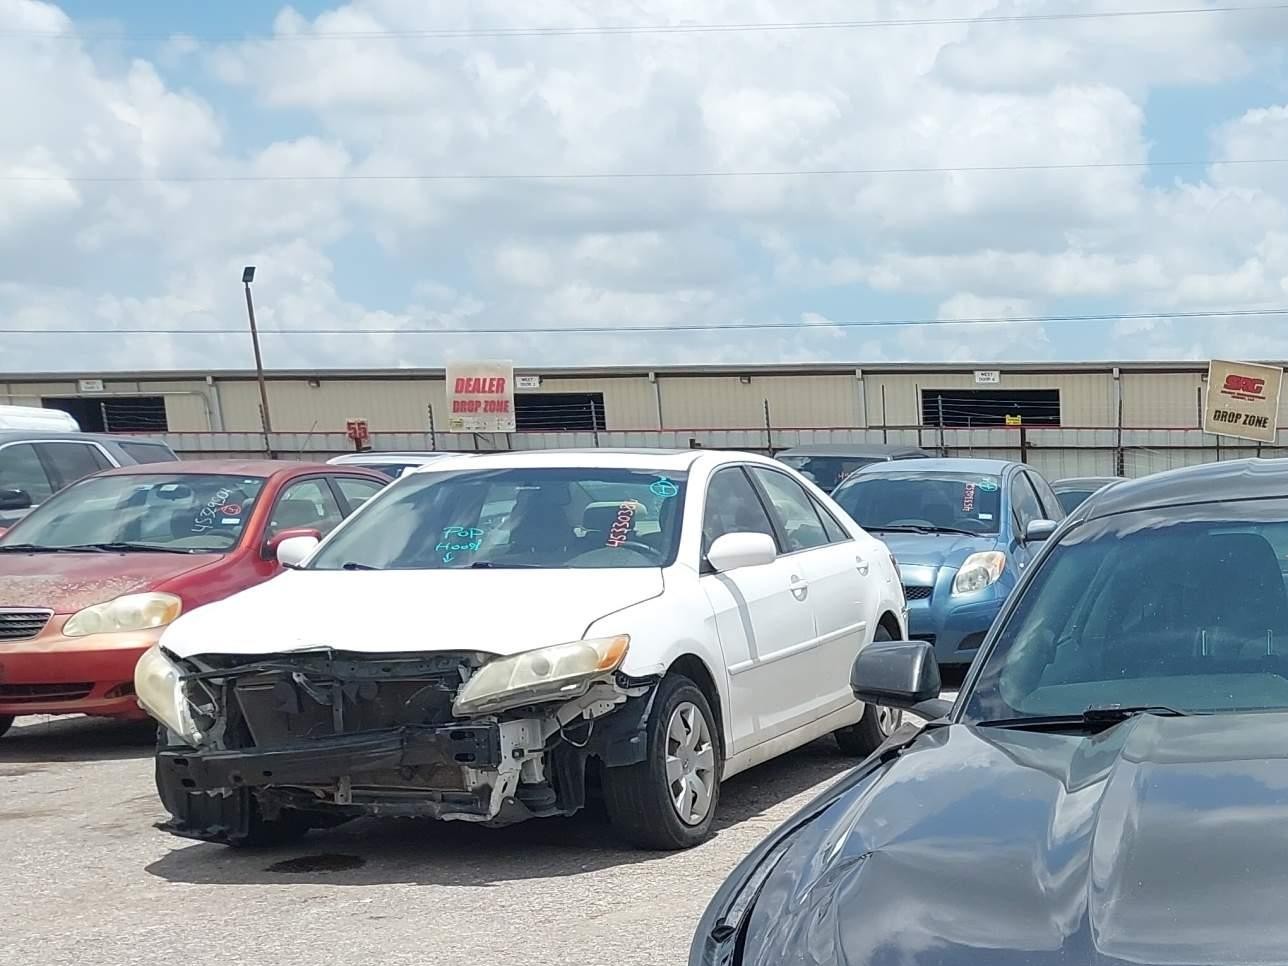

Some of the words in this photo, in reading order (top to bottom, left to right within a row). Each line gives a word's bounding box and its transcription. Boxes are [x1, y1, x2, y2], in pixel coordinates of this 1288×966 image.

[454, 377, 506, 394] DEALER
[1223, 374, 1265, 394] SRG
[452, 400, 481, 414] DROP
[483, 400, 509, 414] ZONE
[1213, 409, 1242, 424] DROP
[1242, 414, 1269, 429] ZONE
[347, 421, 367, 439] 55
